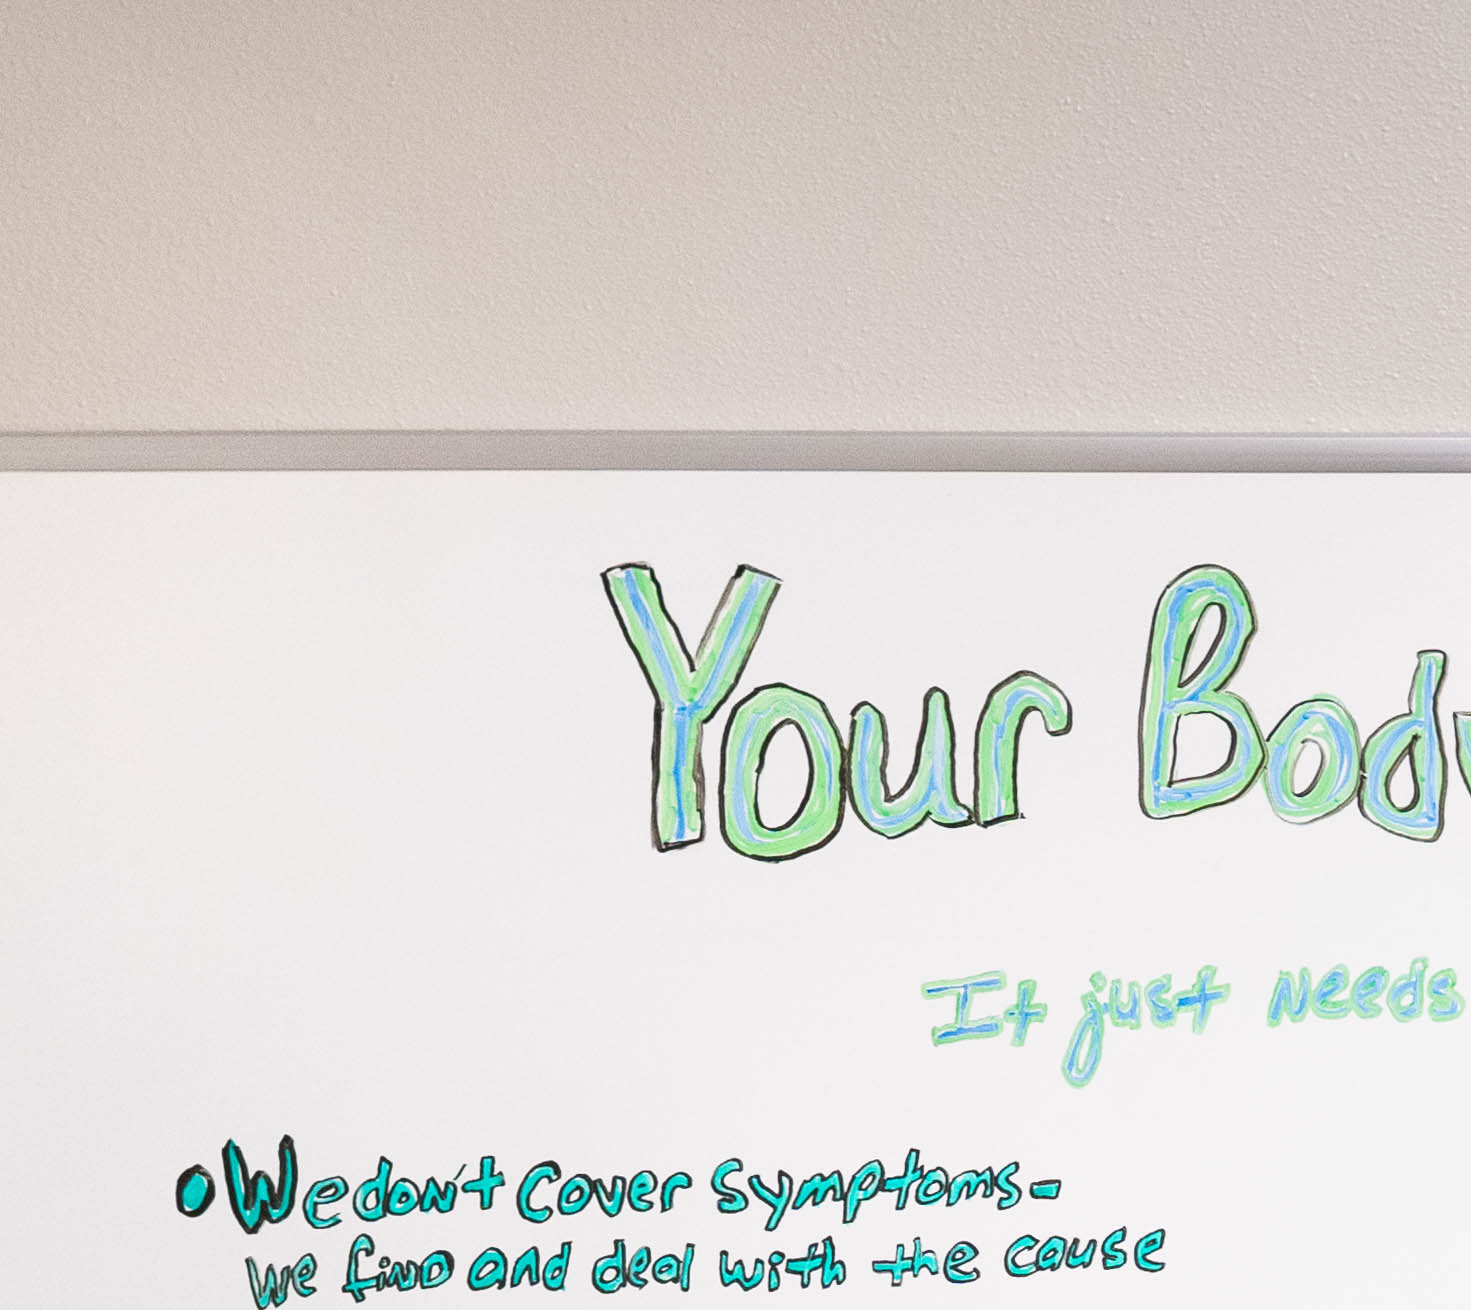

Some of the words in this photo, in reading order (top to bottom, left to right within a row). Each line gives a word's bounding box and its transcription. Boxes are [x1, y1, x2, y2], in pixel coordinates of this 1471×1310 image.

[600, 563, 1072, 863] Your
[922, 976, 1048, 1045] It
[1063, 966, 1225, 1088] just
[467, 1241, 572, 1291] and
[592, 1239, 695, 1294] deal
[719, 1236, 846, 1292] with
[872, 1237, 980, 1287] the
[1004, 1226, 1165, 1277] cause
